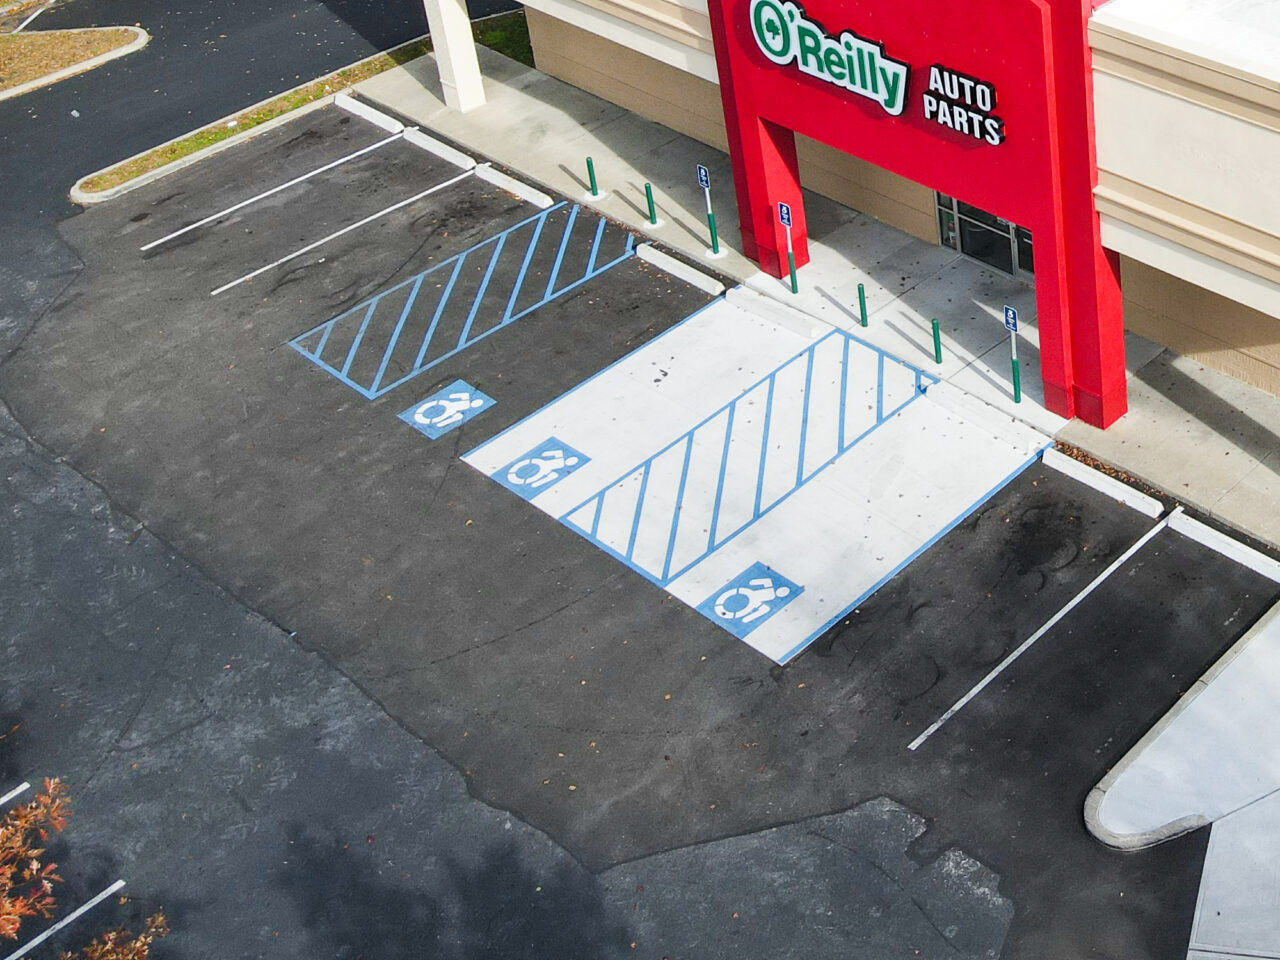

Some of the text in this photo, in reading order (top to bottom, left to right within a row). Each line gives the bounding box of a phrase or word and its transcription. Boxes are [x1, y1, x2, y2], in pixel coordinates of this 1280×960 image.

[753, 0, 900, 109] O'Reilly
[929, 65, 992, 112] AUTO
[923, 93, 1001, 146] PARTS
